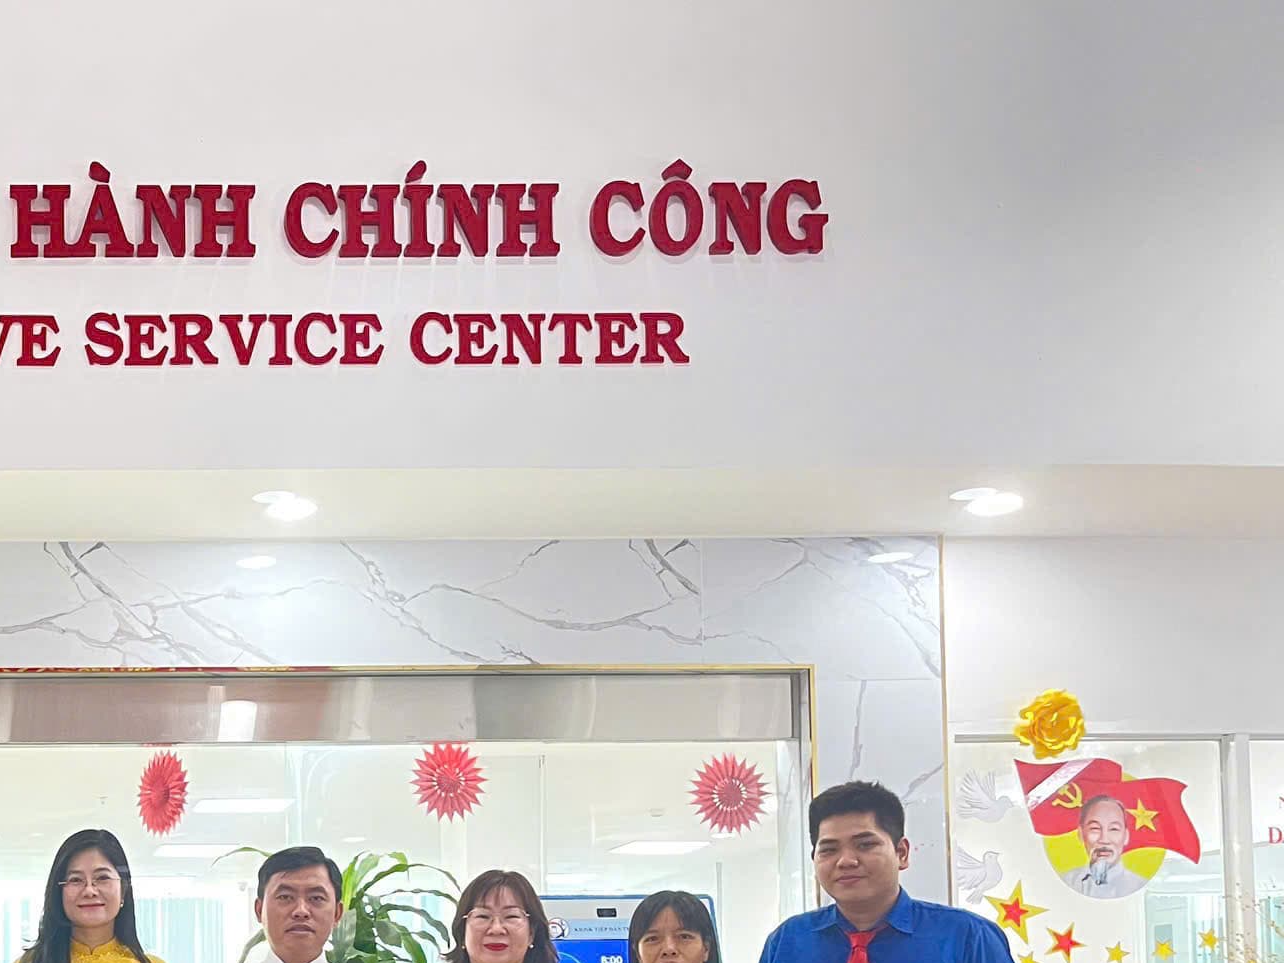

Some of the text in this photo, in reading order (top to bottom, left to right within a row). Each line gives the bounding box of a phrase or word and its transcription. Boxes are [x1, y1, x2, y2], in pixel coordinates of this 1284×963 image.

[10, 163, 255, 258] HÀNH
[285, 162, 559, 257] CHÍNH
[591, 160, 828, 256] CÔNG
[85, 312, 383, 366] SERVICE
[410, 312, 689, 365] CENTER
